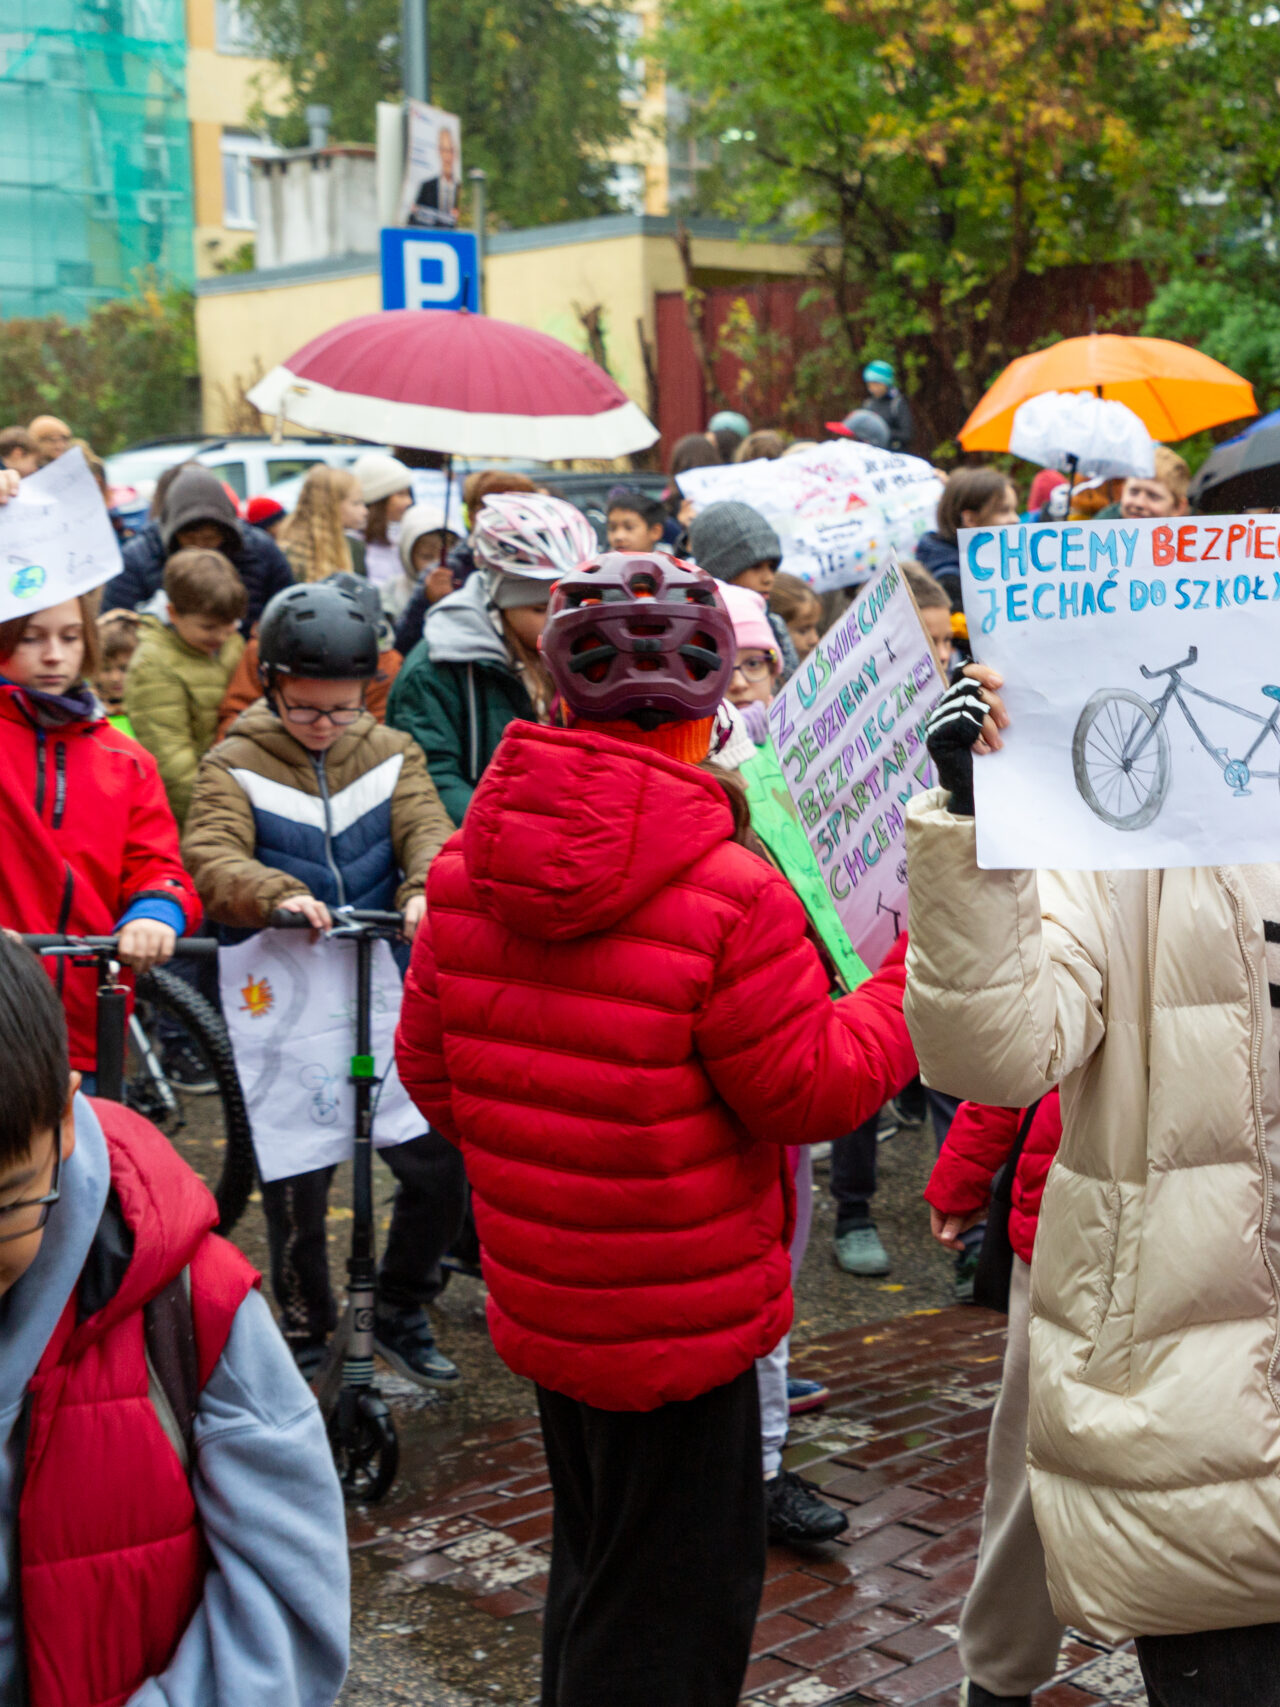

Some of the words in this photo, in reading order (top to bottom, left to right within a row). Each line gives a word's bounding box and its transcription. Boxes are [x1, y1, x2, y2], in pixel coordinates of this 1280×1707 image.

[403, 240, 461, 311] P
[968, 526, 1139, 581] CHCEMY
[979, 569, 1120, 633] JECHAĆ
[1131, 580, 1166, 611] DO
[770, 694, 795, 750] Z
[797, 564, 900, 709] UŚMIECHEM
[784, 656, 881, 783] JEDZIEMY
[817, 692, 944, 865] SPARTAŃSK
